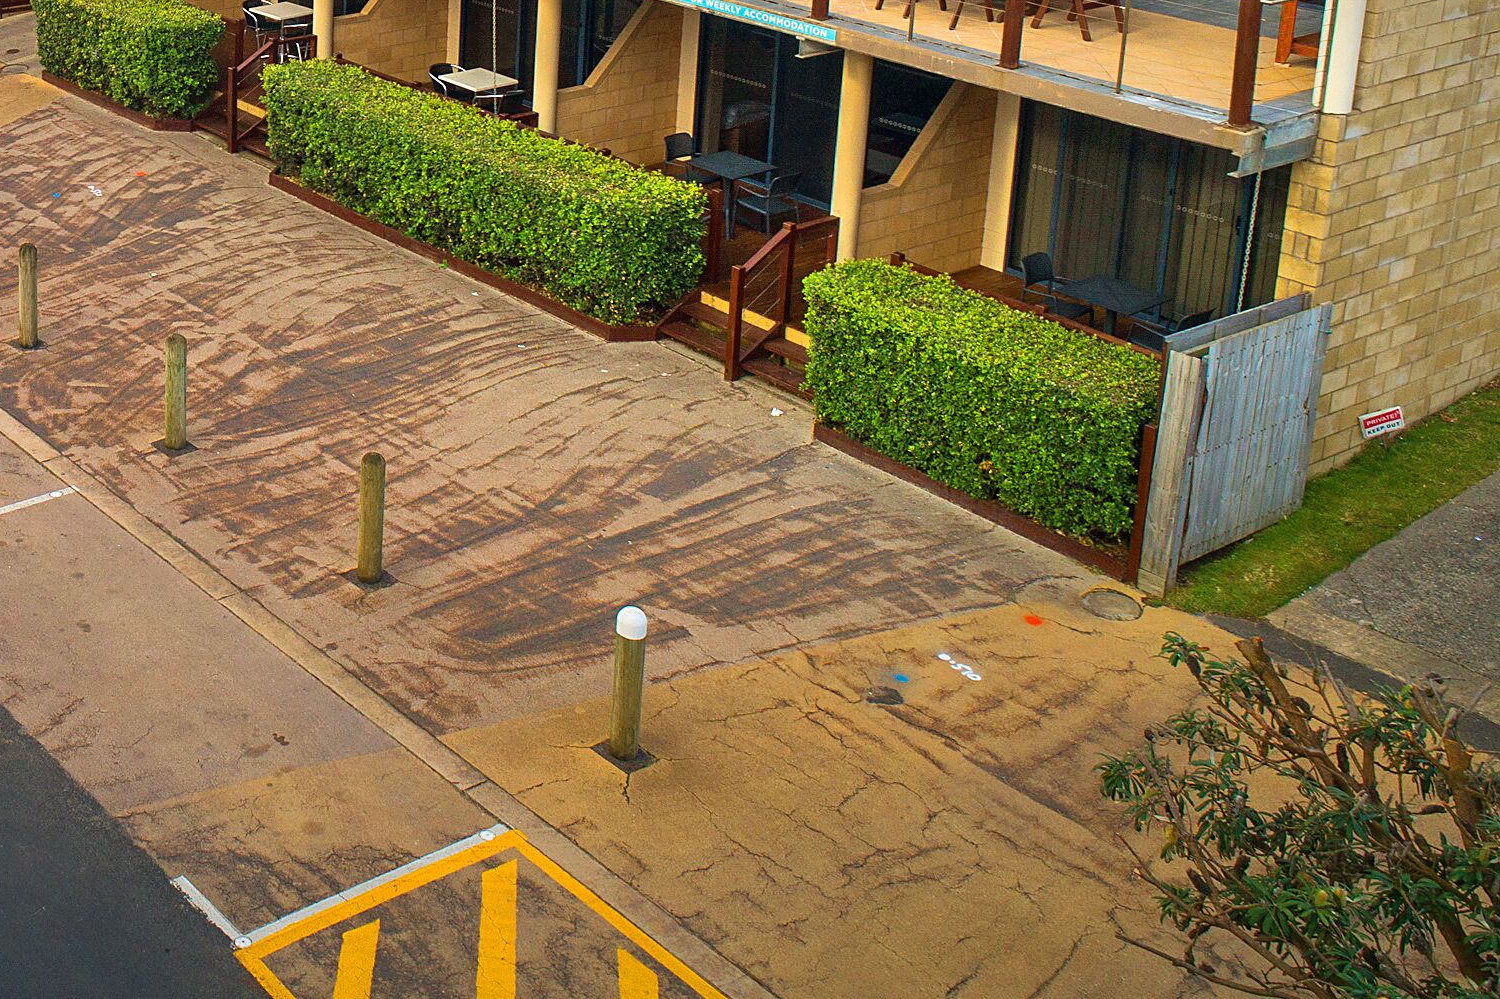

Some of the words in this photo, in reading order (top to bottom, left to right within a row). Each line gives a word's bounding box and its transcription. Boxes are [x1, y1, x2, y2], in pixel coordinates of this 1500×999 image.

[705, 0, 741, 14] WEEKLY
[743, 8, 828, 38] ACCOMMODATION
[1367, 425, 1385, 435] KEEP
[1386, 421, 1400, 429] OUT
